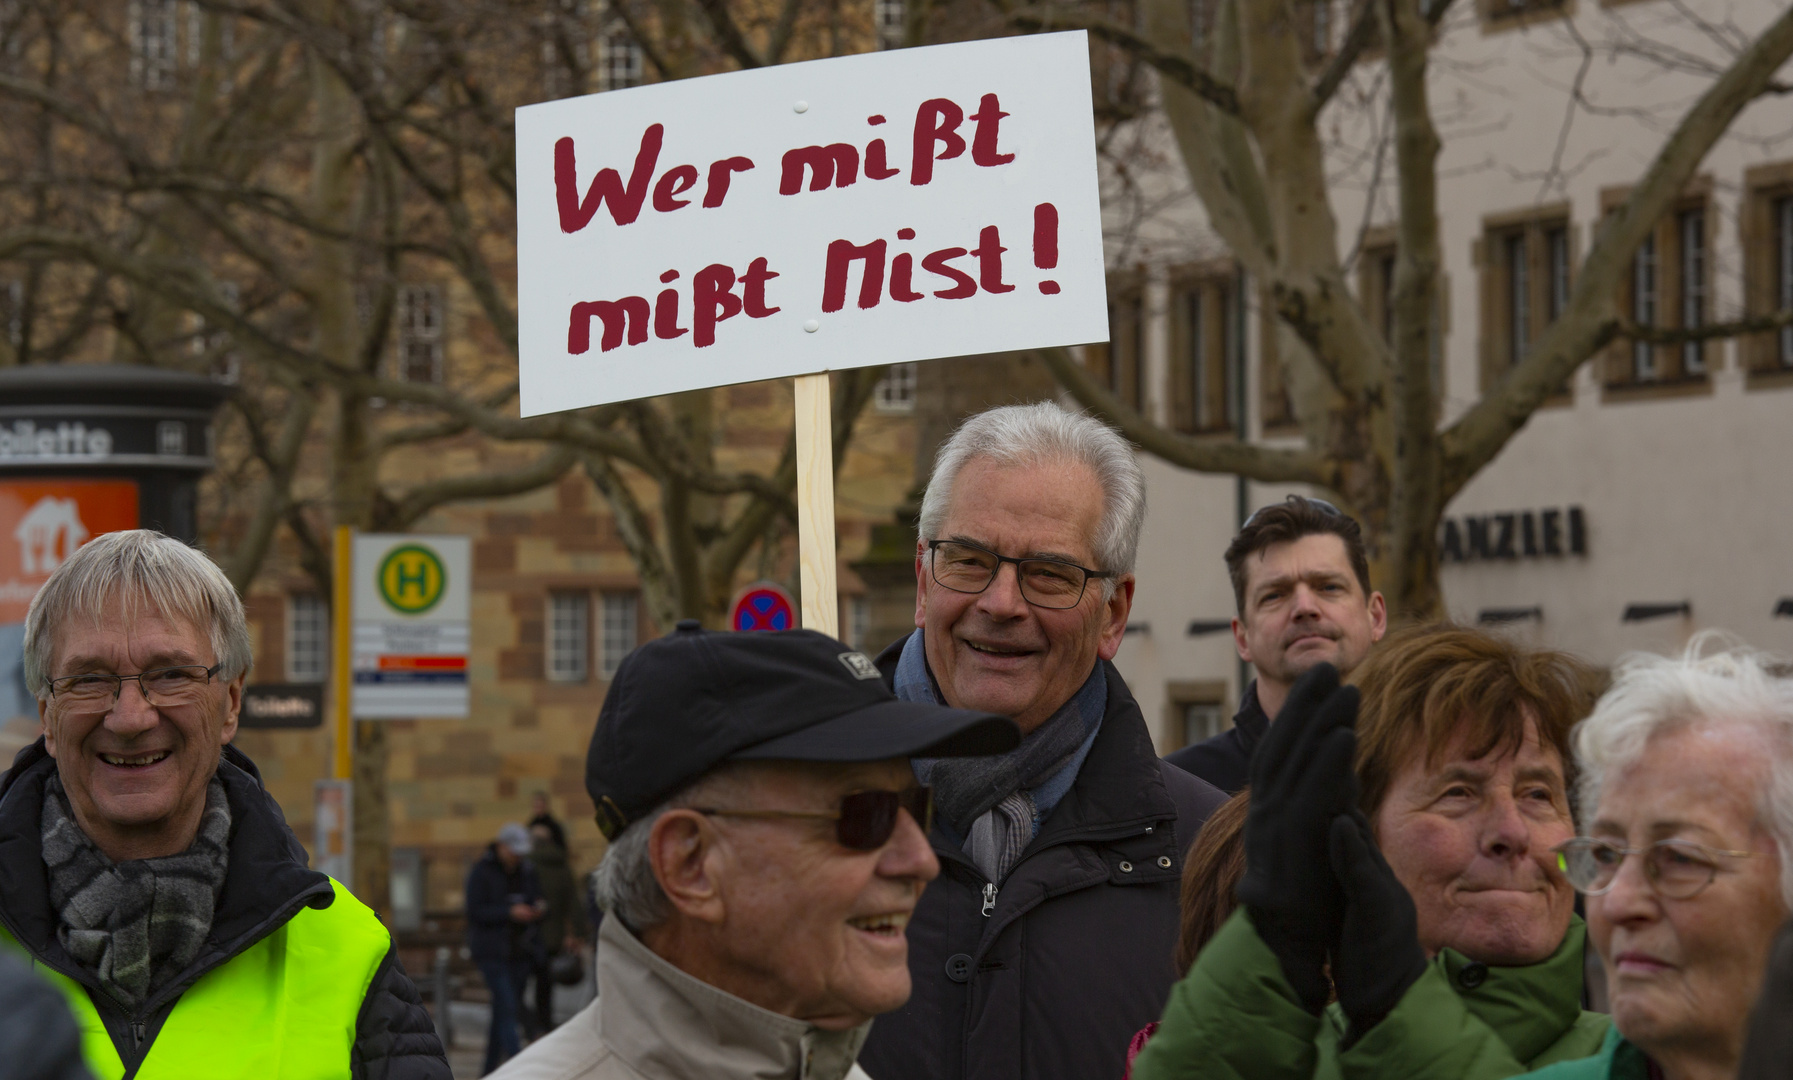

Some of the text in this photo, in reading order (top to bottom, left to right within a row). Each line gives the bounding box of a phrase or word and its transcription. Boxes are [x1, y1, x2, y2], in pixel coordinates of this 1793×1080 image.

[554, 93, 1016, 234] Wer mißt
[567, 256, 781, 355] mißt
[0, 418, 113, 456] oilette
[1438, 505, 1588, 562] ANZLEI
[398, 562, 426, 598] H
